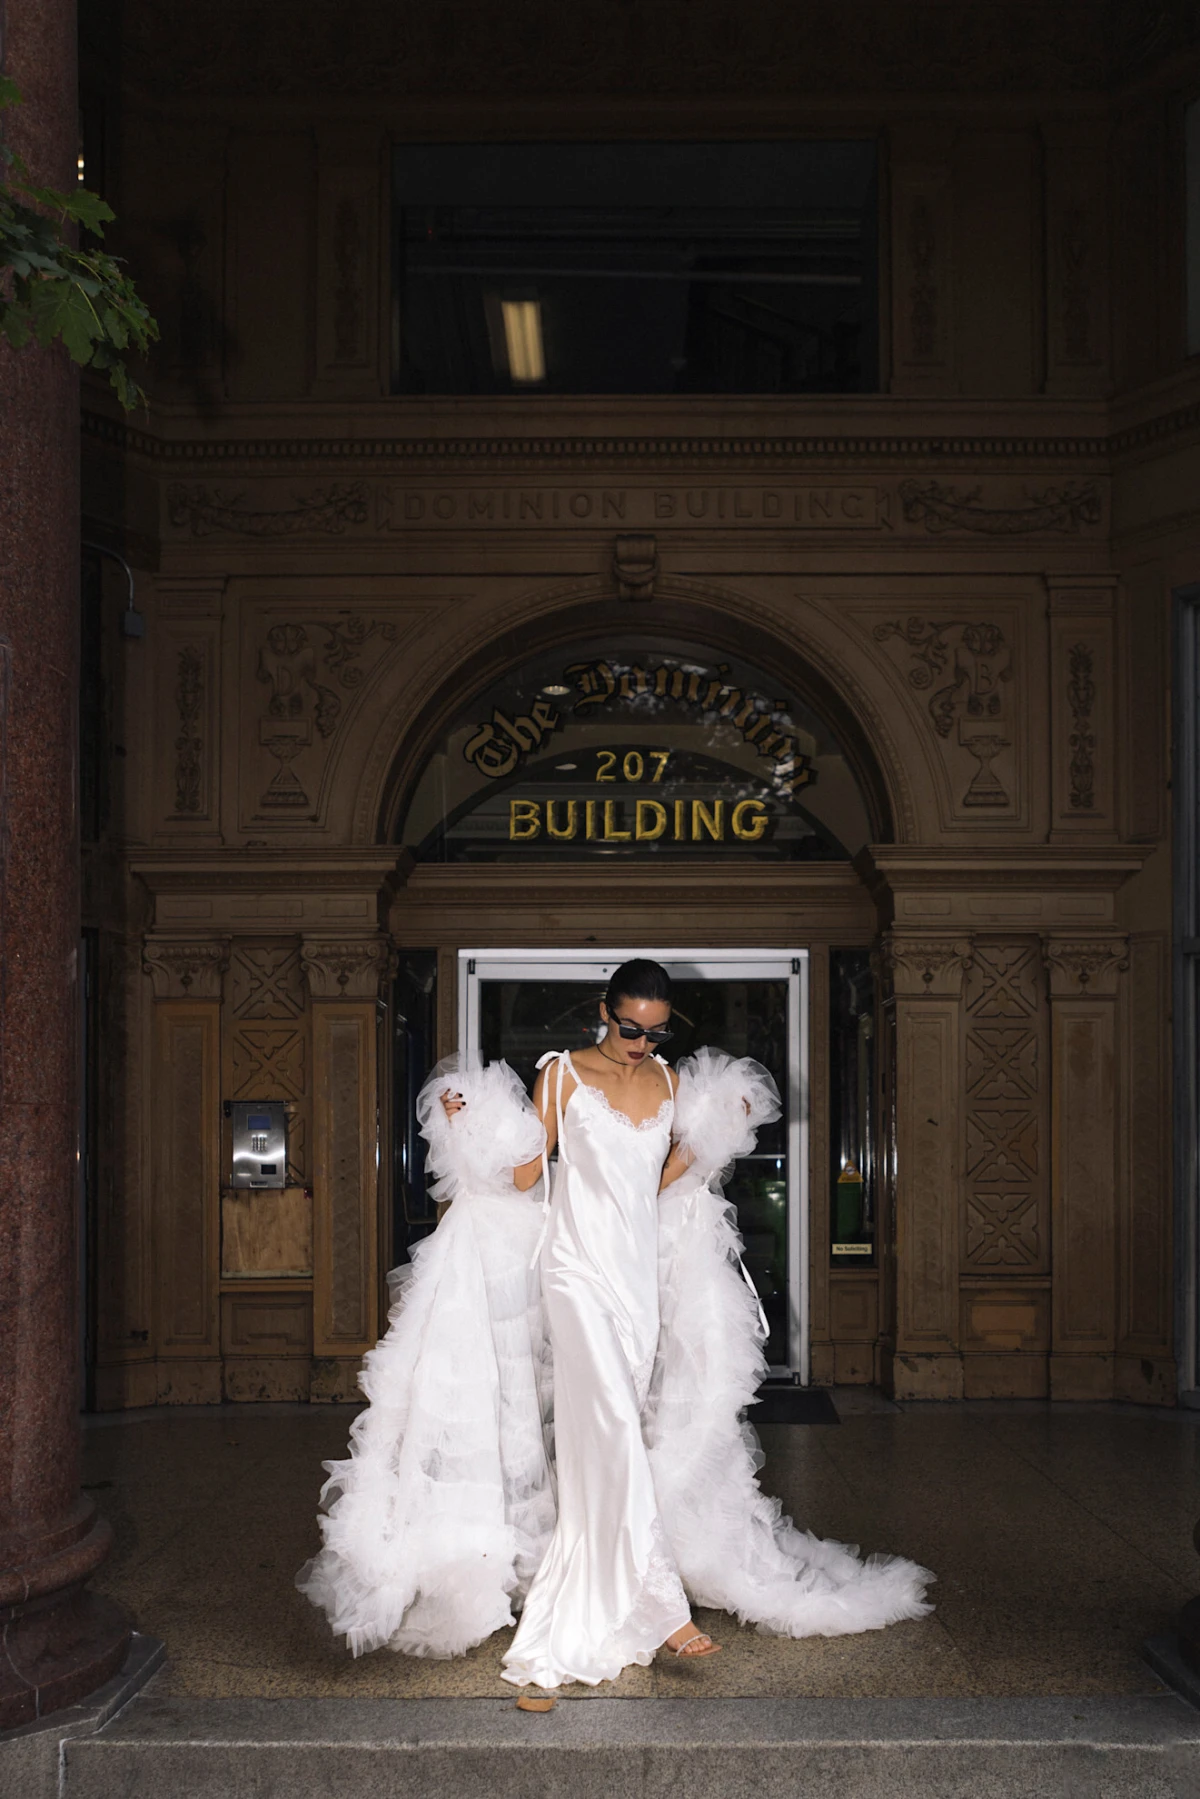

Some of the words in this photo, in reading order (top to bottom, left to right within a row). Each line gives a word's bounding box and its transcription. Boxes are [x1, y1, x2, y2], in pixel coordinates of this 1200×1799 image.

[404, 491, 626, 520] DOMINION
[275, 664, 296, 697] D
[974, 661, 997, 696] B
[463, 699, 562, 778] The
[563, 658, 815, 794] Dominion
[595, 750, 671, 783] 207
[508, 799, 770, 841] BUILDING
